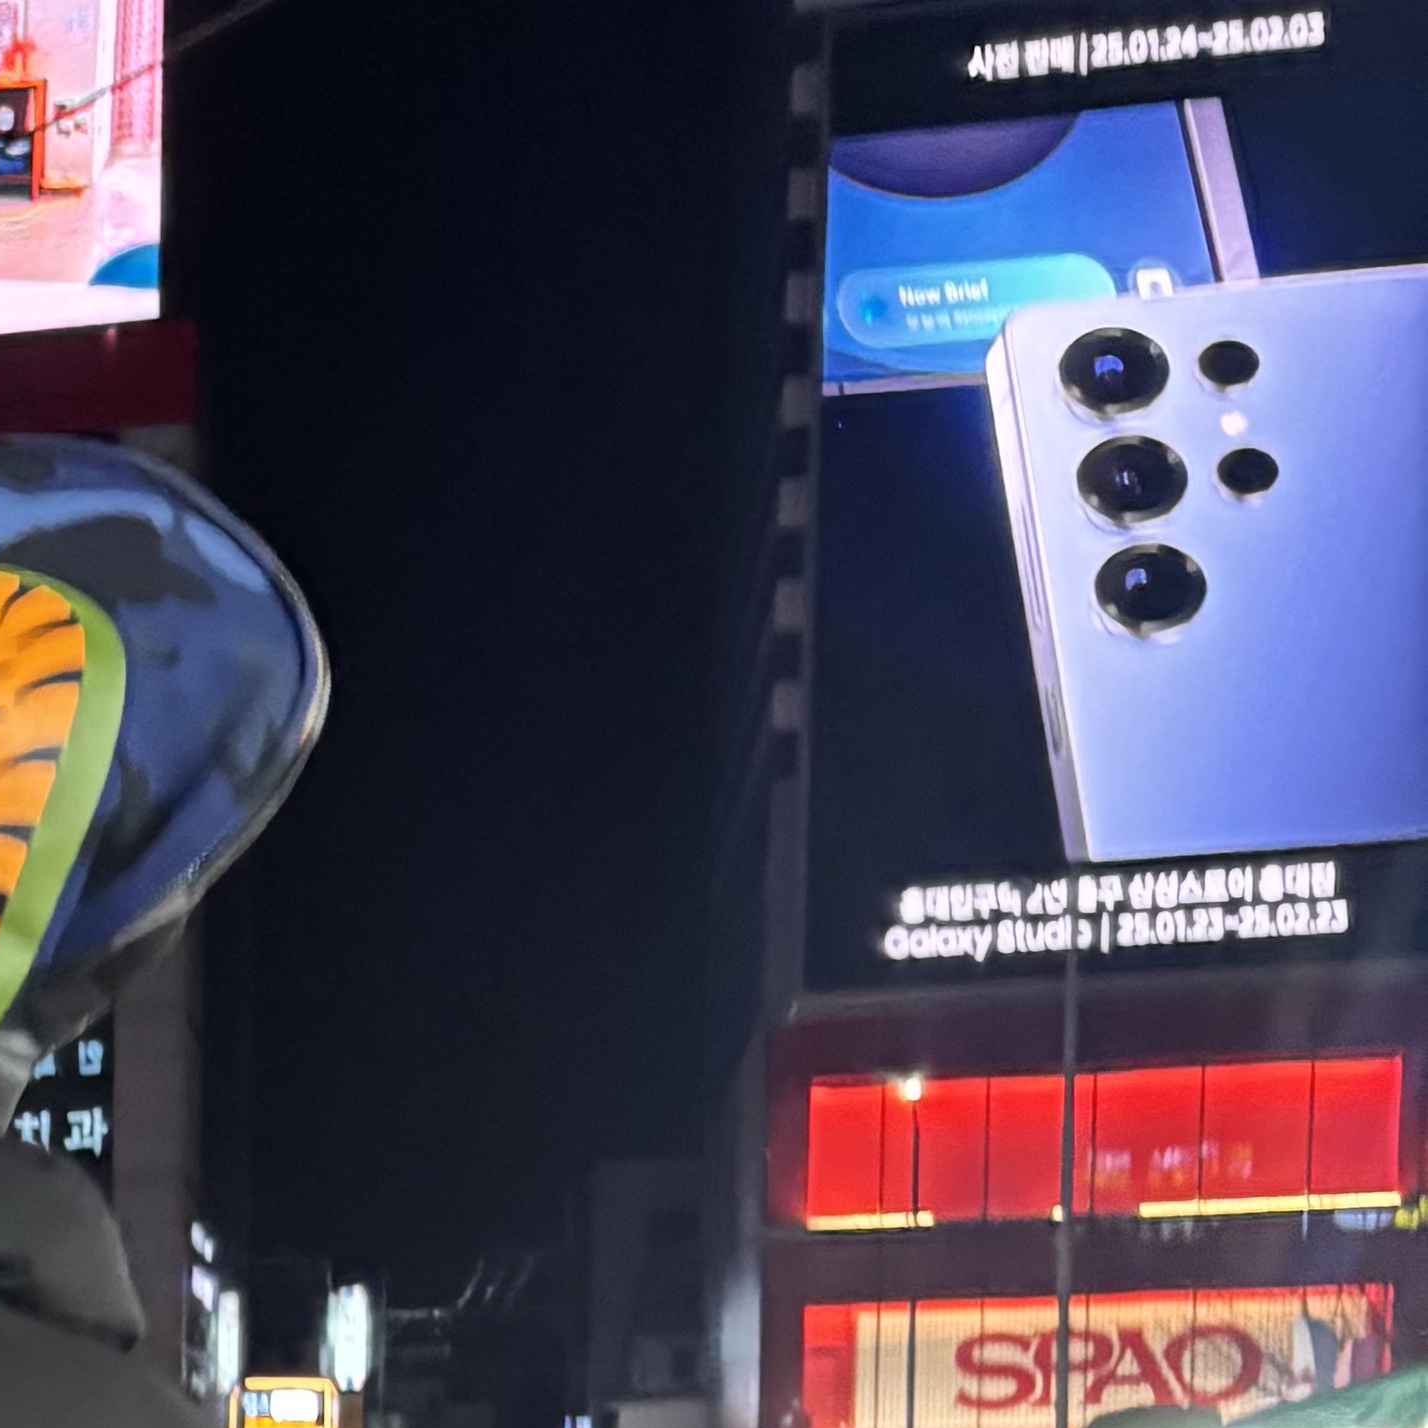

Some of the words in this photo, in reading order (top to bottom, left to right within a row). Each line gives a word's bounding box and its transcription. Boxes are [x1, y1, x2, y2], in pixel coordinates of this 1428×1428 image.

[884, 922, 993, 963] Galaxy
[997, 913, 1092, 954] Studio
[954, 1323, 1264, 1410] SPAO
